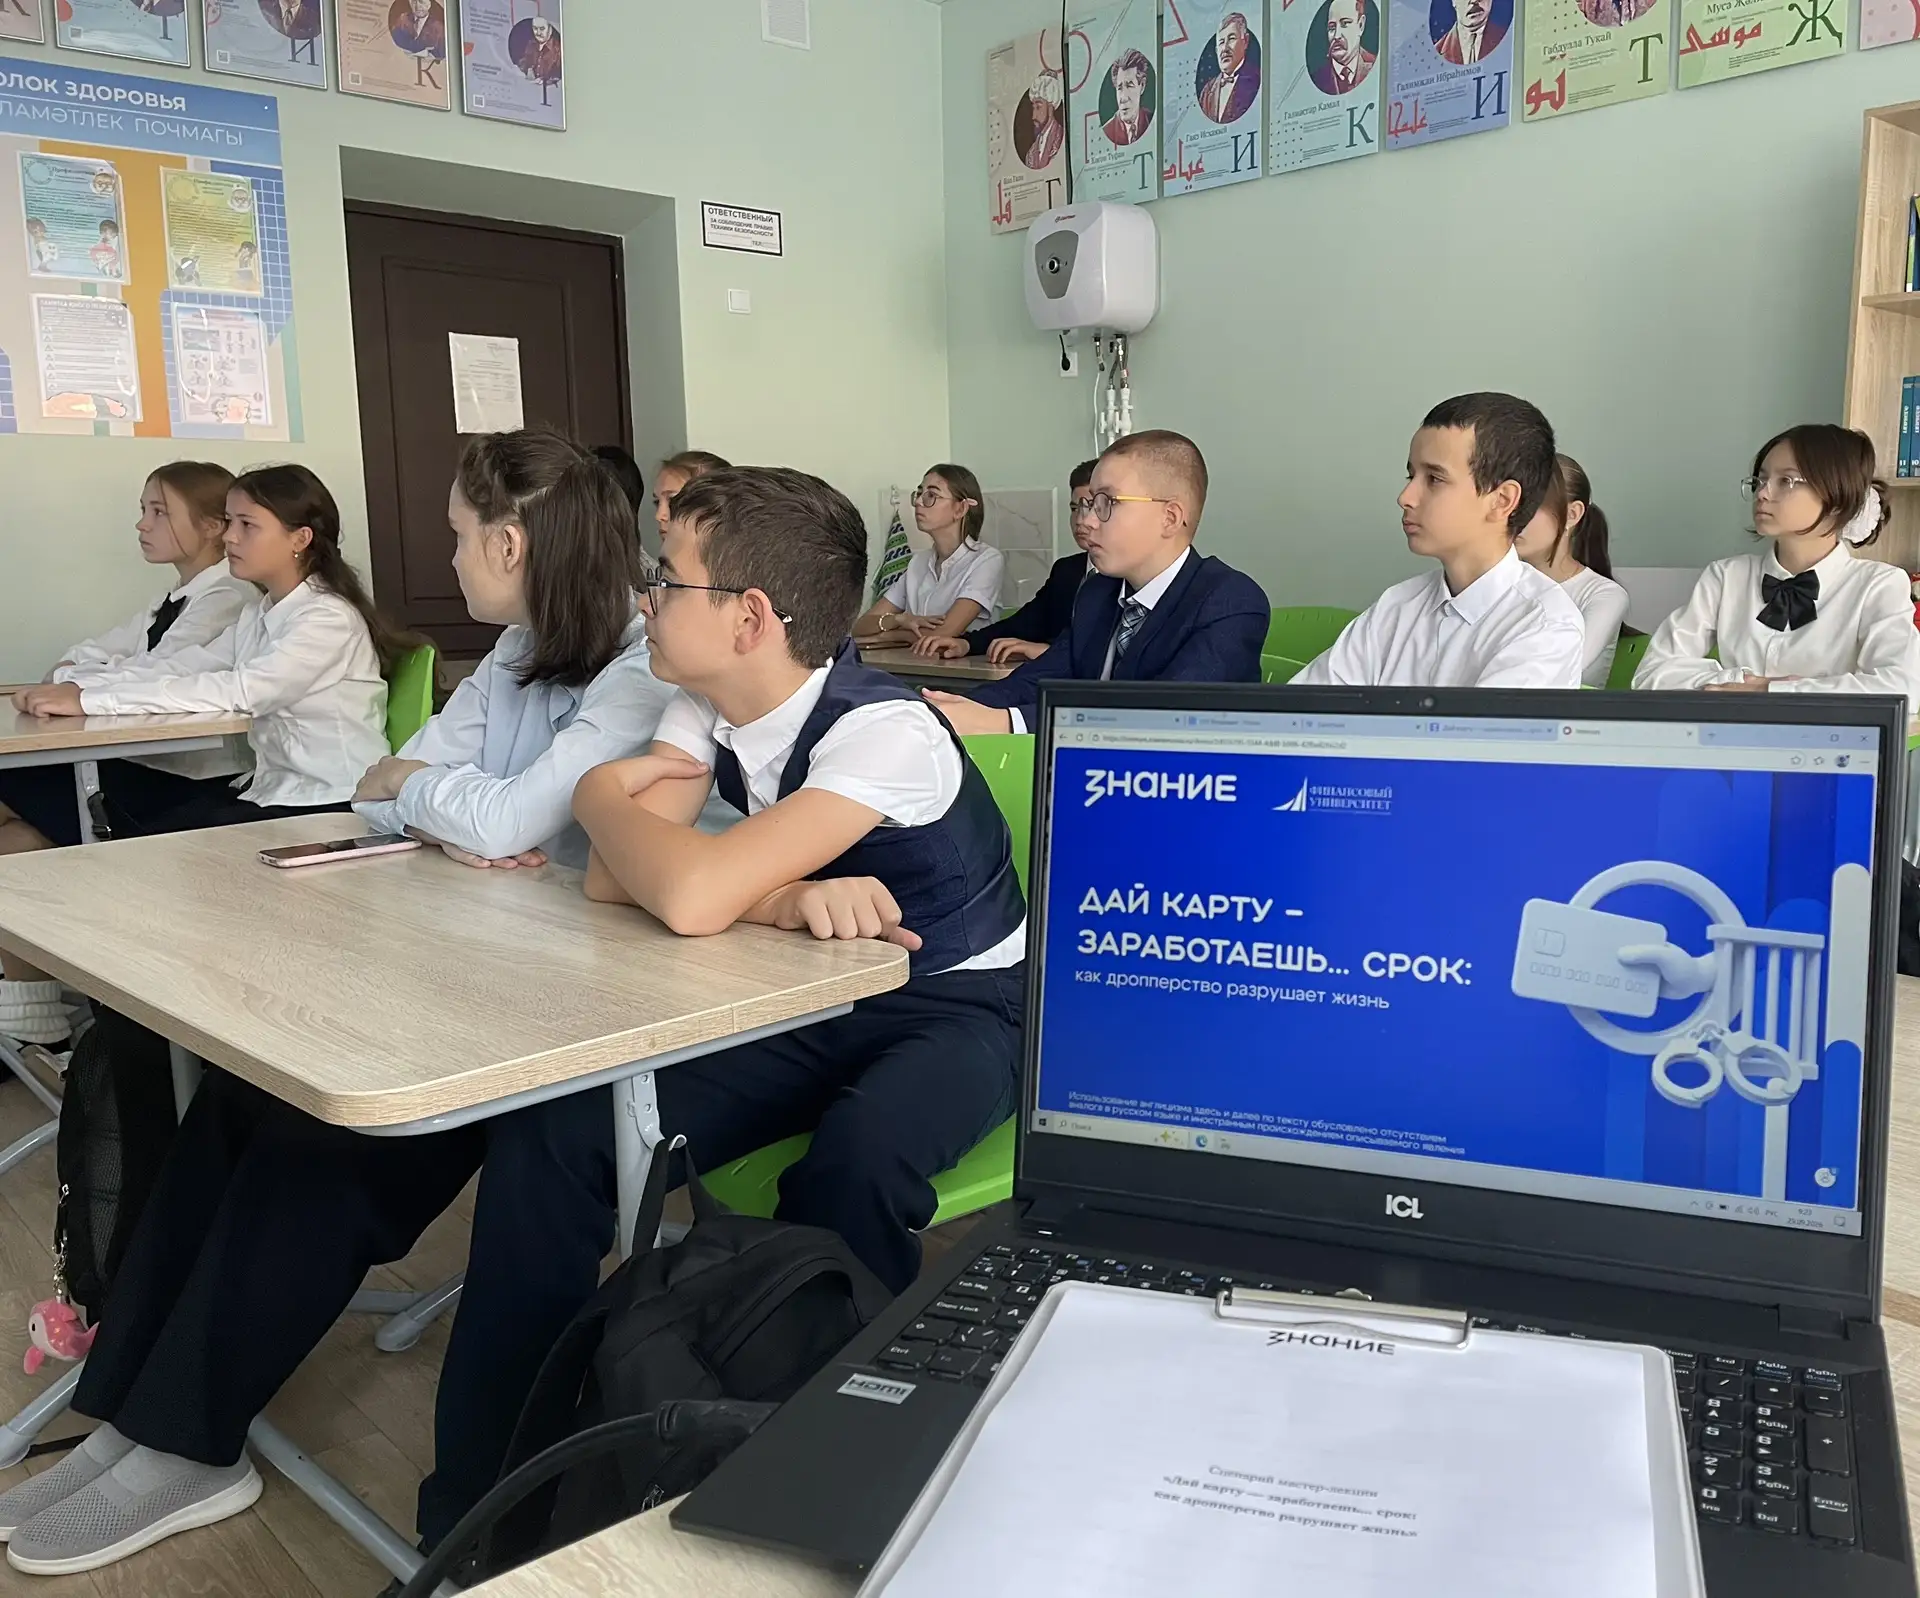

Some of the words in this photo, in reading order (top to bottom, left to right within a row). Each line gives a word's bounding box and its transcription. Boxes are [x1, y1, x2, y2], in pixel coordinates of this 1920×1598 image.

[1543, 39, 1583, 56] Габдулла
[1585, 31, 1612, 47] Тукай
[1629, 32, 1664, 84] Т
[414, 56, 442, 90] К
[64, 80, 187, 112] ЗДОРОВЬЯ
[1471, 70, 1508, 120] И
[134, 117, 244, 147] ПОЧМАГЫ
[1345, 102, 1375, 149] К
[1230, 130, 1258, 174] И
[1132, 151, 1154, 191] Т
[708, 207, 773, 223] ОТВЕТСТВЕННЫЙ
[1309, 784, 1393, 799] ФИНАНСОВЫЙ
[1309, 796, 1391, 811] УНИВЕРСИТЕТ
[1078, 882, 1150, 915] ДАЙ
[1162, 891, 1274, 923] КАРТУ
[1362, 950, 1473, 986] СРОК:
[1075, 968, 1101, 984] как
[1105, 973, 1222, 996] дропперство
[1226, 981, 1326, 1004] разрушает
[1331, 991, 1390, 1010] жизнь
[1068, 1090, 1138, 1107] Использование
[1194, 1106, 1222, 1117] здесь
[1231, 1111, 1260, 1122] далее
[1261, 1114, 1275, 1123] по
[1277, 1115, 1309, 1128] тексту
[1311, 1119, 1379, 1136] обусловлено
[1379, 1129, 1447, 1144] отсутствием
[1111, 1106, 1152, 1117] русском
[1190, 1116, 1256, 1131] иностранным
[1256, 1123, 1344, 1140] происхождением
[1345, 1134, 1420, 1150] описываемого
[1385, 1194, 1424, 1220] ICL
[1715, 1356, 1736, 1365] End
[1757, 1360, 1787, 1370] PgUp
[1807, 1367, 1837, 1377] PgDn
[1708, 1398, 1721, 1408] 8
[1757, 1406, 1771, 1416] 9
[1706, 1426, 1720, 1436] 5
[1758, 1419, 1788, 1430] PgUp
[1757, 1435, 1772, 1445] 6
[1704, 1456, 1719, 1467] 2
[1757, 1465, 1772, 1476] 3
[1208, 1464, 1275, 1485] Сценарий
[1277, 1478, 1378, 1499] мастер-лекции
[1702, 1487, 1718, 1499] 0
[1758, 1479, 1790, 1491] PgDn
[1163, 1474, 1200, 1489] «Дай
[1202, 1482, 1246, 1498] карту
[1376, 1507, 1418, 1521] срок:
[1813, 1496, 1849, 1508] Enter
[1153, 1490, 1181, 1503] как
[1181, 1496, 1277, 1520] дропперство
[1278, 1513, 1359, 1532] разрушает
[1359, 1524, 1418, 1538] жизнь»
[1757, 1512, 1779, 1523] Del
